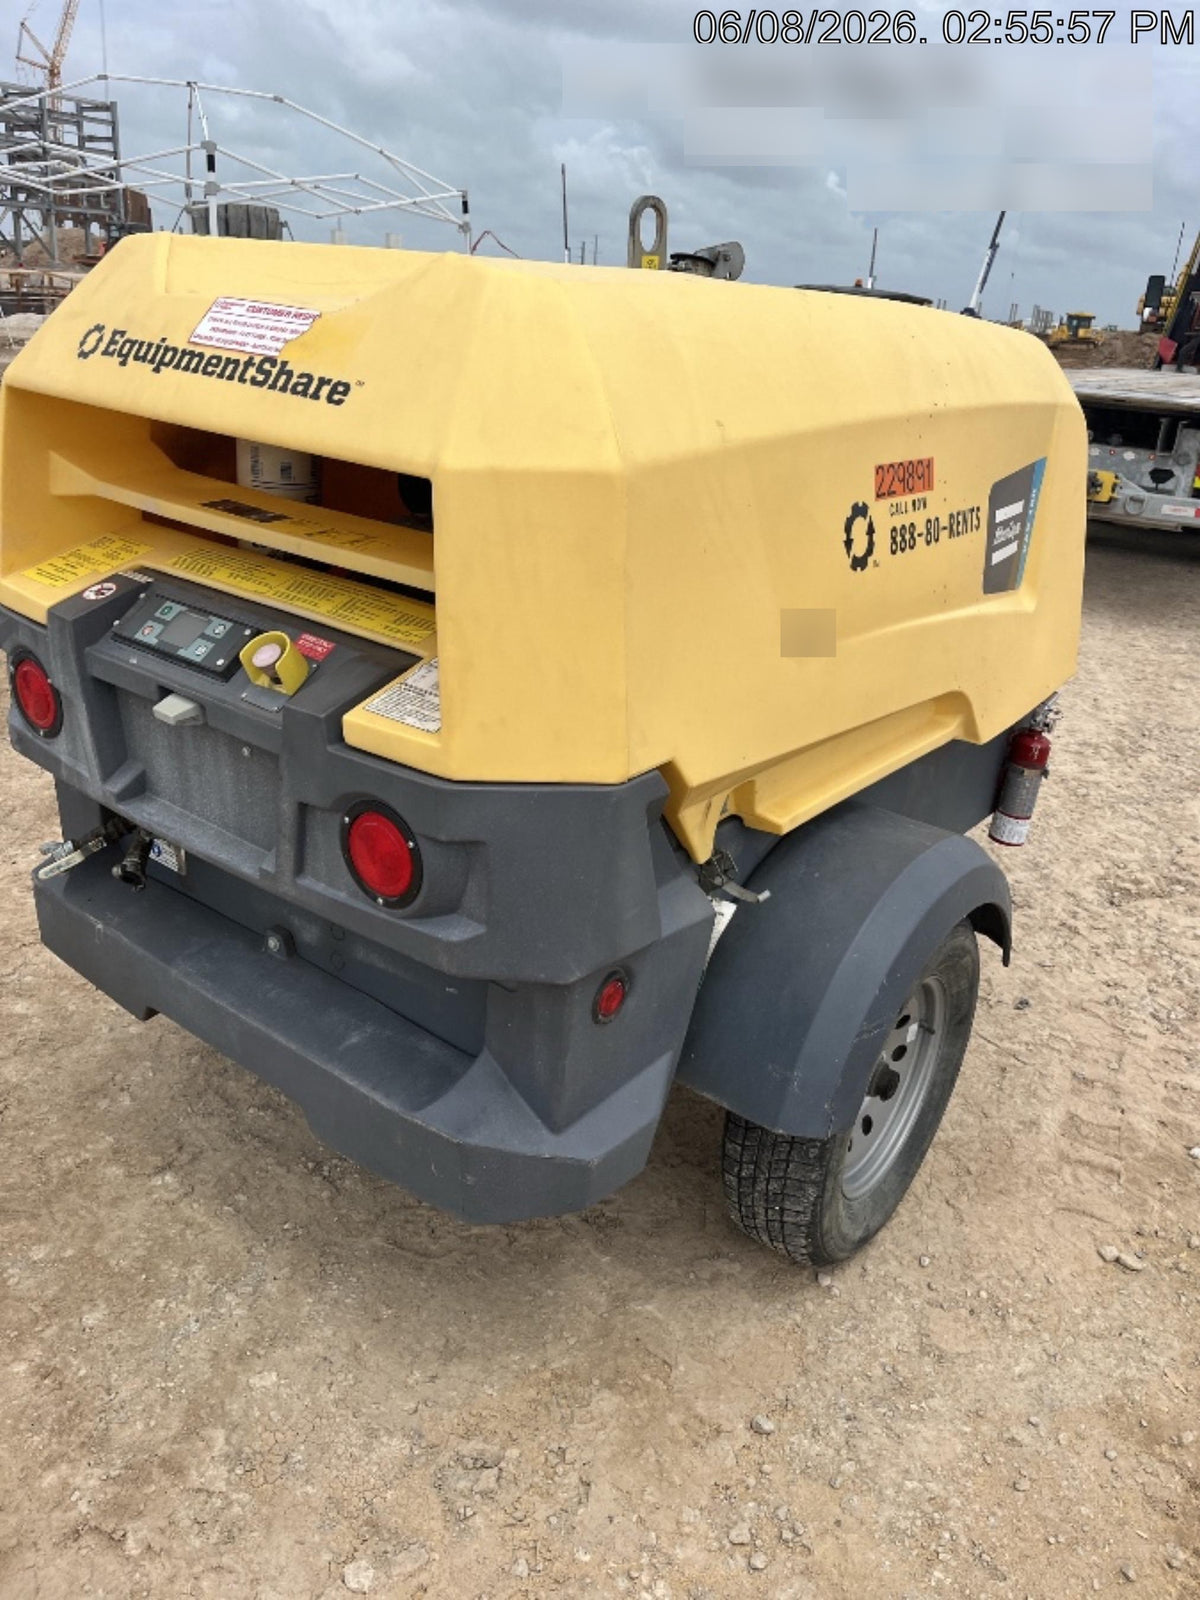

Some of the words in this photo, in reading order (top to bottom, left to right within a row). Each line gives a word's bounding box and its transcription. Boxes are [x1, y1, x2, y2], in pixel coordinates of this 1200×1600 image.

[101, 328, 352, 406] EquipmentShare
[876, 459, 931, 498] 229891
[889, 501, 908, 517] CALL
[912, 497, 927, 512] NOW
[890, 506, 980, 555] 888-80-RENTS
